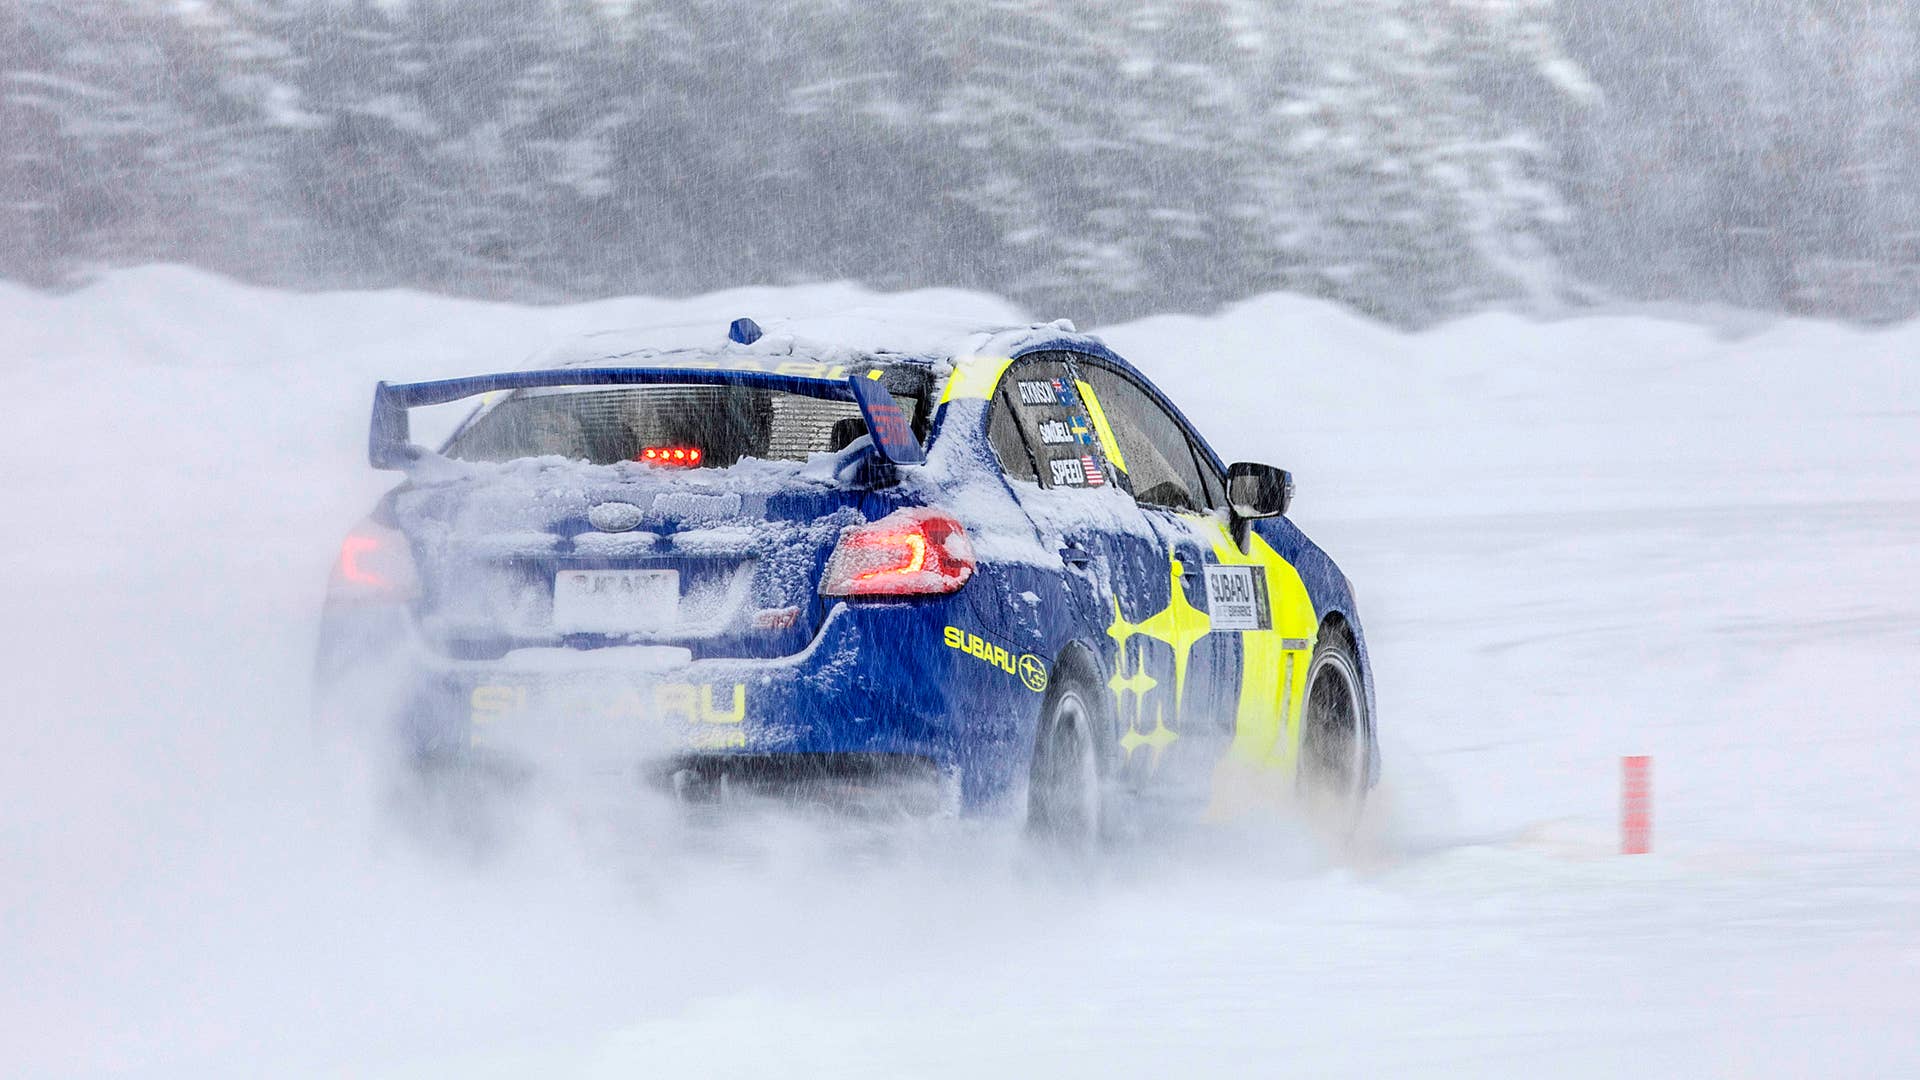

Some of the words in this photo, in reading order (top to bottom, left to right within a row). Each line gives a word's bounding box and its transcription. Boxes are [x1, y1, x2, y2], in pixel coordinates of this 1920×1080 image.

[1018, 381, 1057, 404] ATKINSON
[1050, 459, 1084, 485] SPEED
[1211, 574, 1250, 602] SUBARU
[944, 626, 1016, 675] SUBARU
